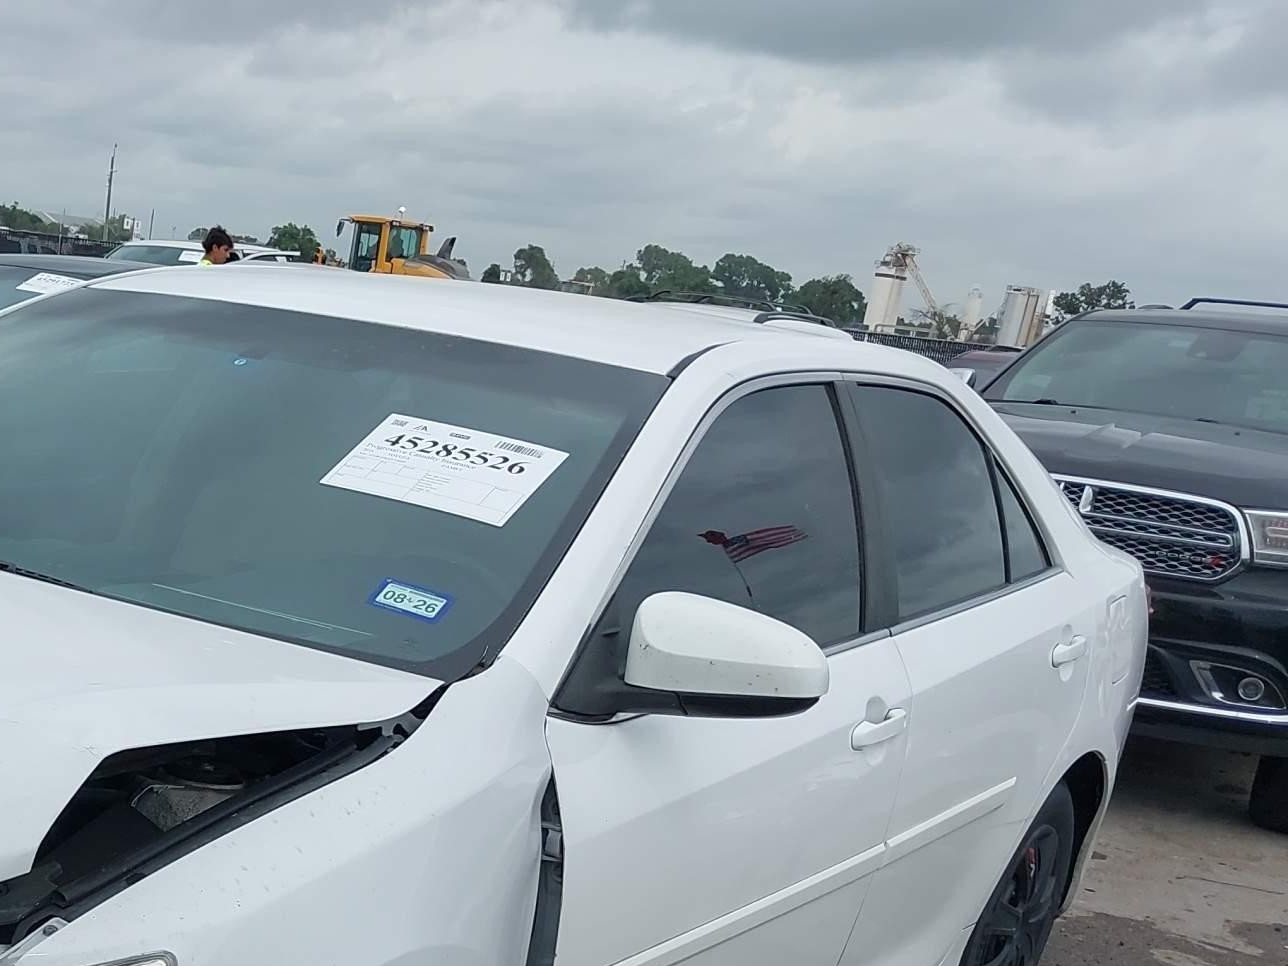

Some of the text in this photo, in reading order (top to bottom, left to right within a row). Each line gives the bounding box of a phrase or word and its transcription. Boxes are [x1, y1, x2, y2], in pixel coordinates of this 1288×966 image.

[384, 434, 528, 475] 45285526
[383, 590, 408, 604] 08
[412, 600, 439, 614] 26
